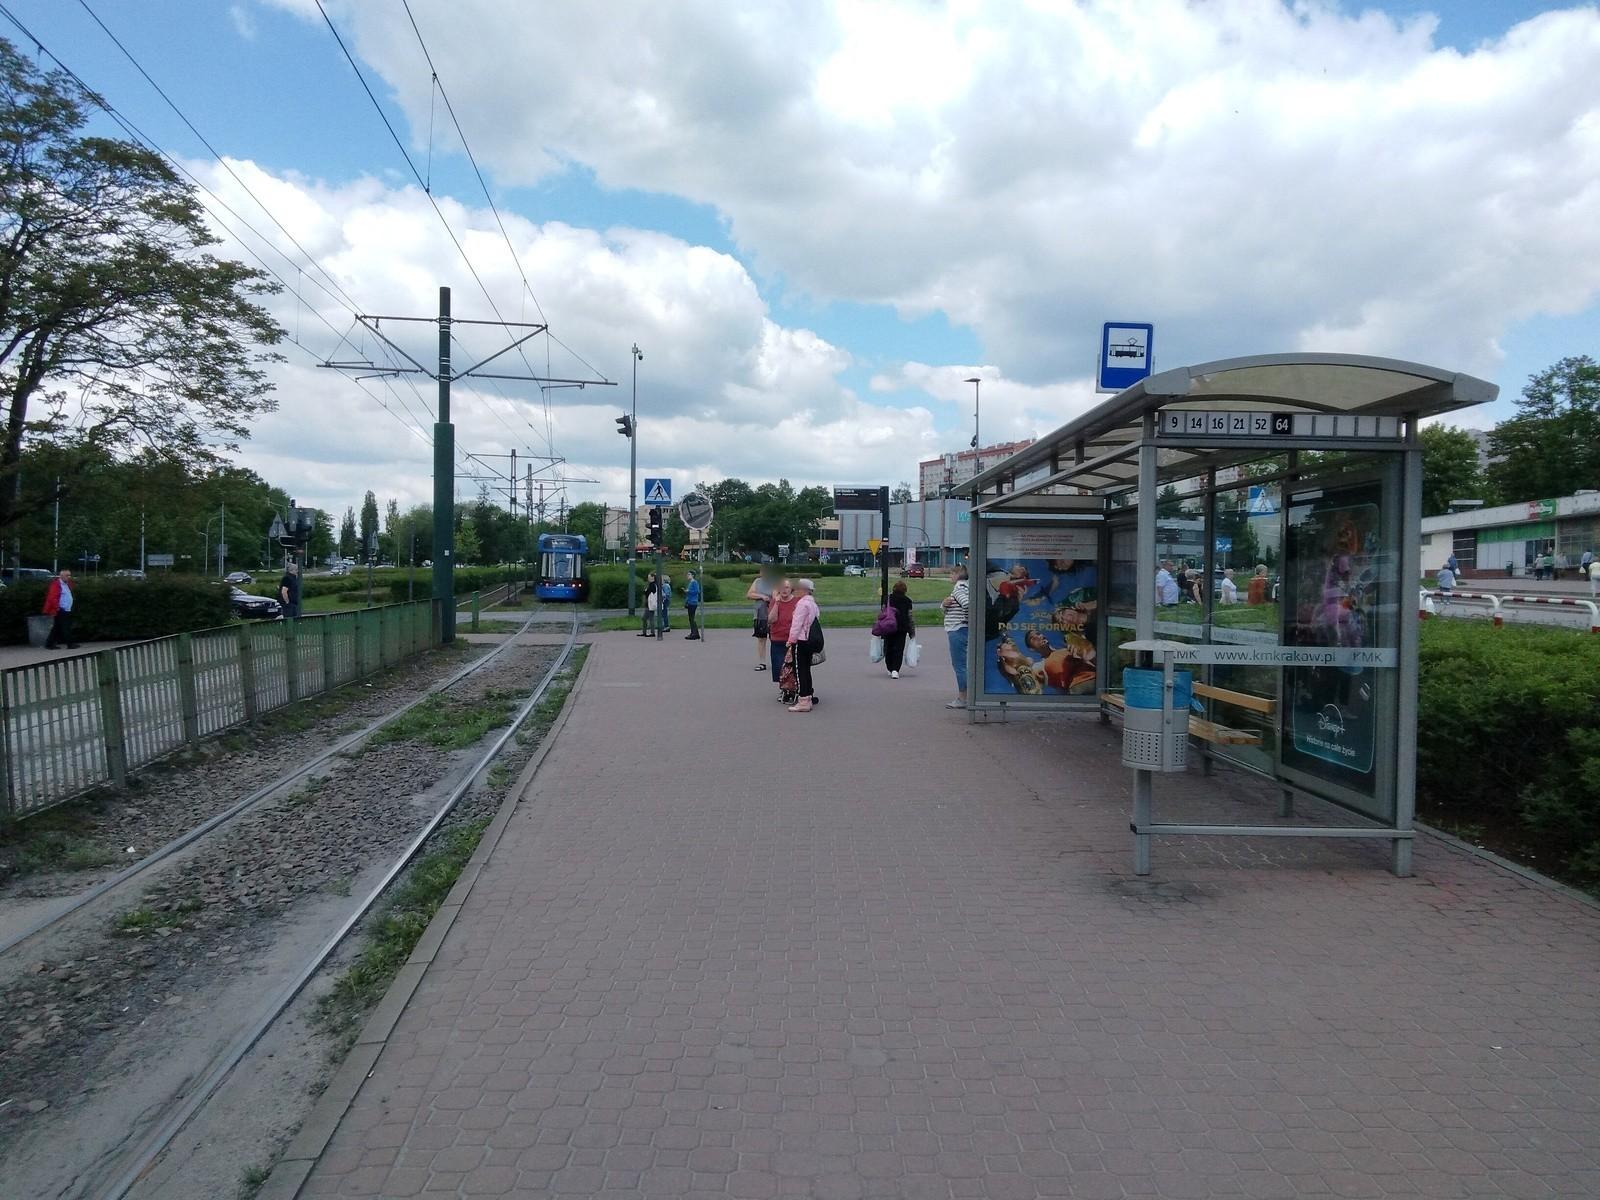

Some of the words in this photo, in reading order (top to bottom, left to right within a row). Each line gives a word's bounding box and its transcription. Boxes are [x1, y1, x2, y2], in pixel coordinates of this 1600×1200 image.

[1171, 416, 1178, 428] 9
[1191, 417, 1202, 429] 14
[1212, 418, 1224, 430] 16
[1233, 418, 1245, 430] 21
[1255, 418, 1267, 430] 52
[1275, 418, 1289, 431] 64
[1173, 650, 1198, 660] MK
[1214, 649, 1336, 664] www.kmkrakow.pl
